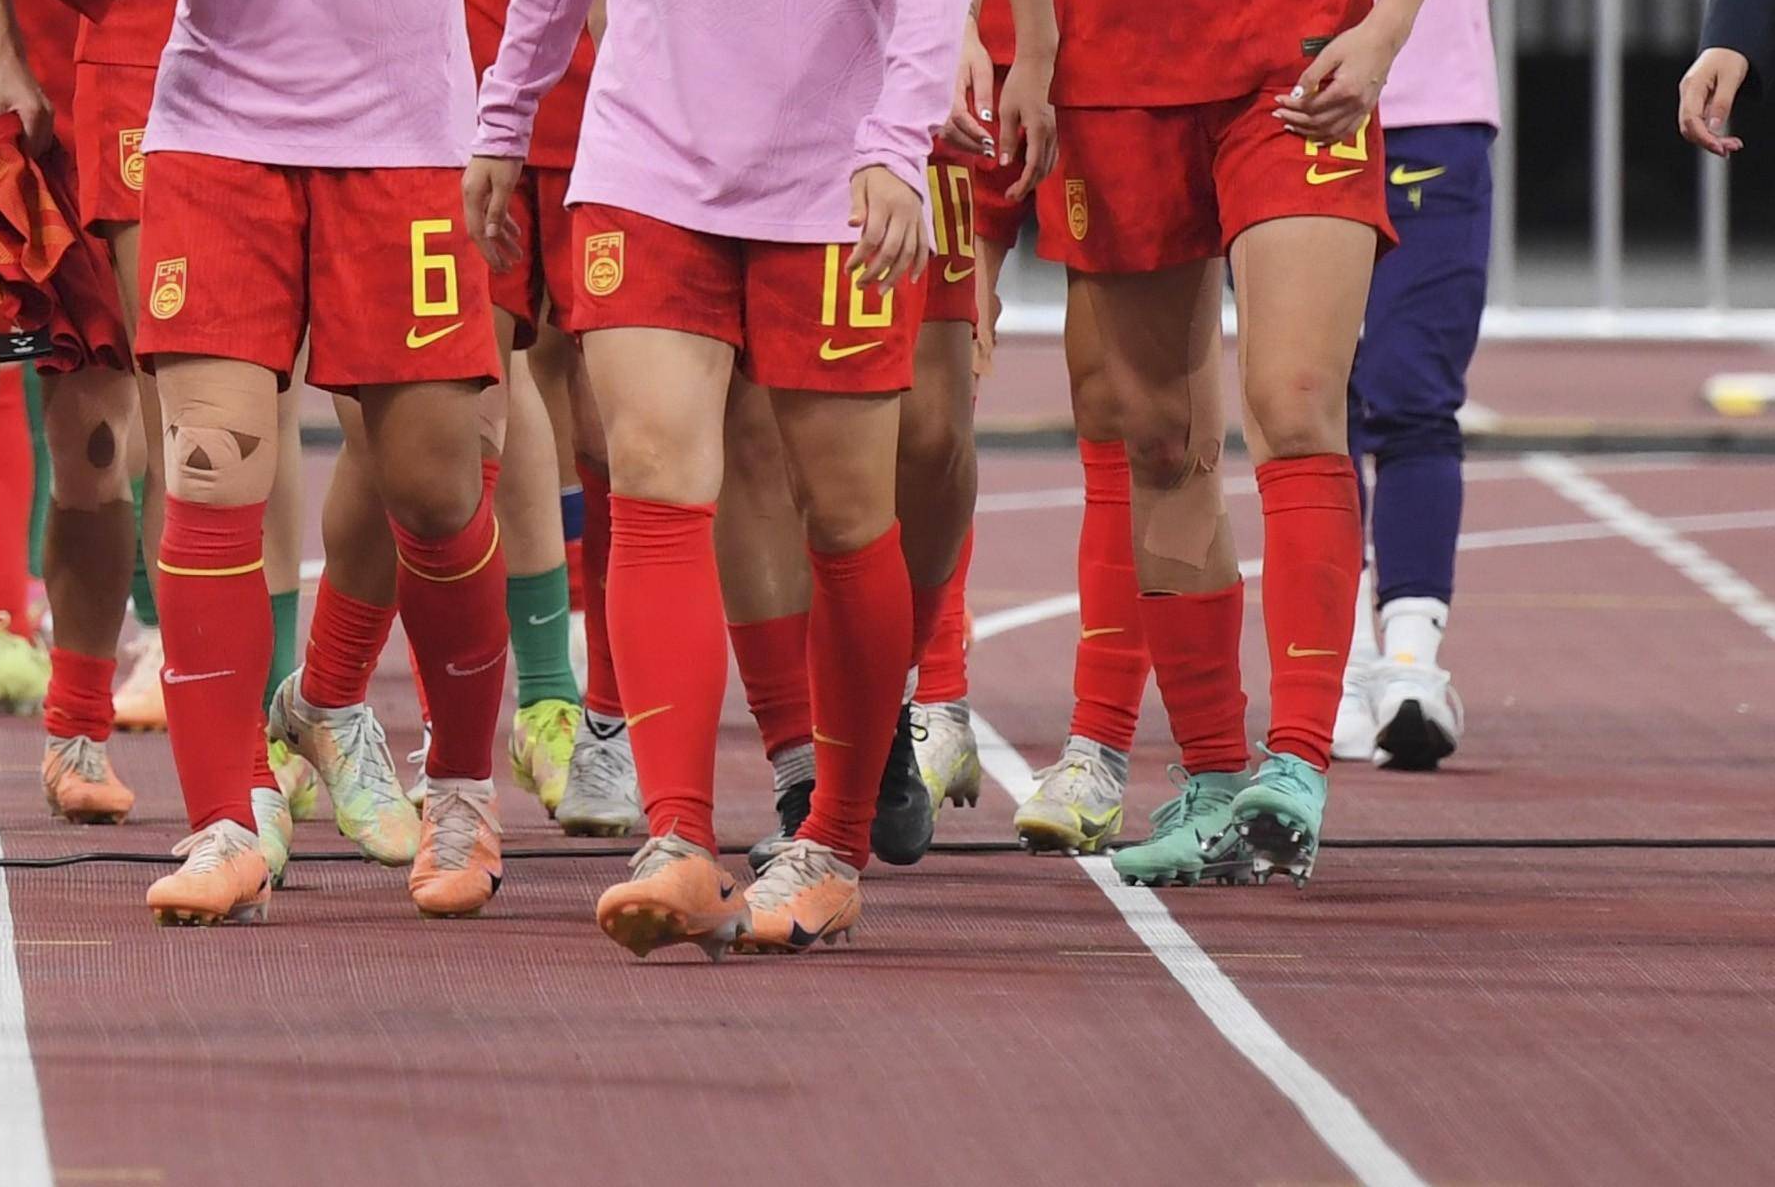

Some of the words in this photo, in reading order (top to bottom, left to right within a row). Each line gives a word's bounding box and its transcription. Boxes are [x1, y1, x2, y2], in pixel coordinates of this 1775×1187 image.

[589, 236, 619, 252] CFA
[159, 263, 185, 276] CFA
[411, 219, 459, 316] 6
